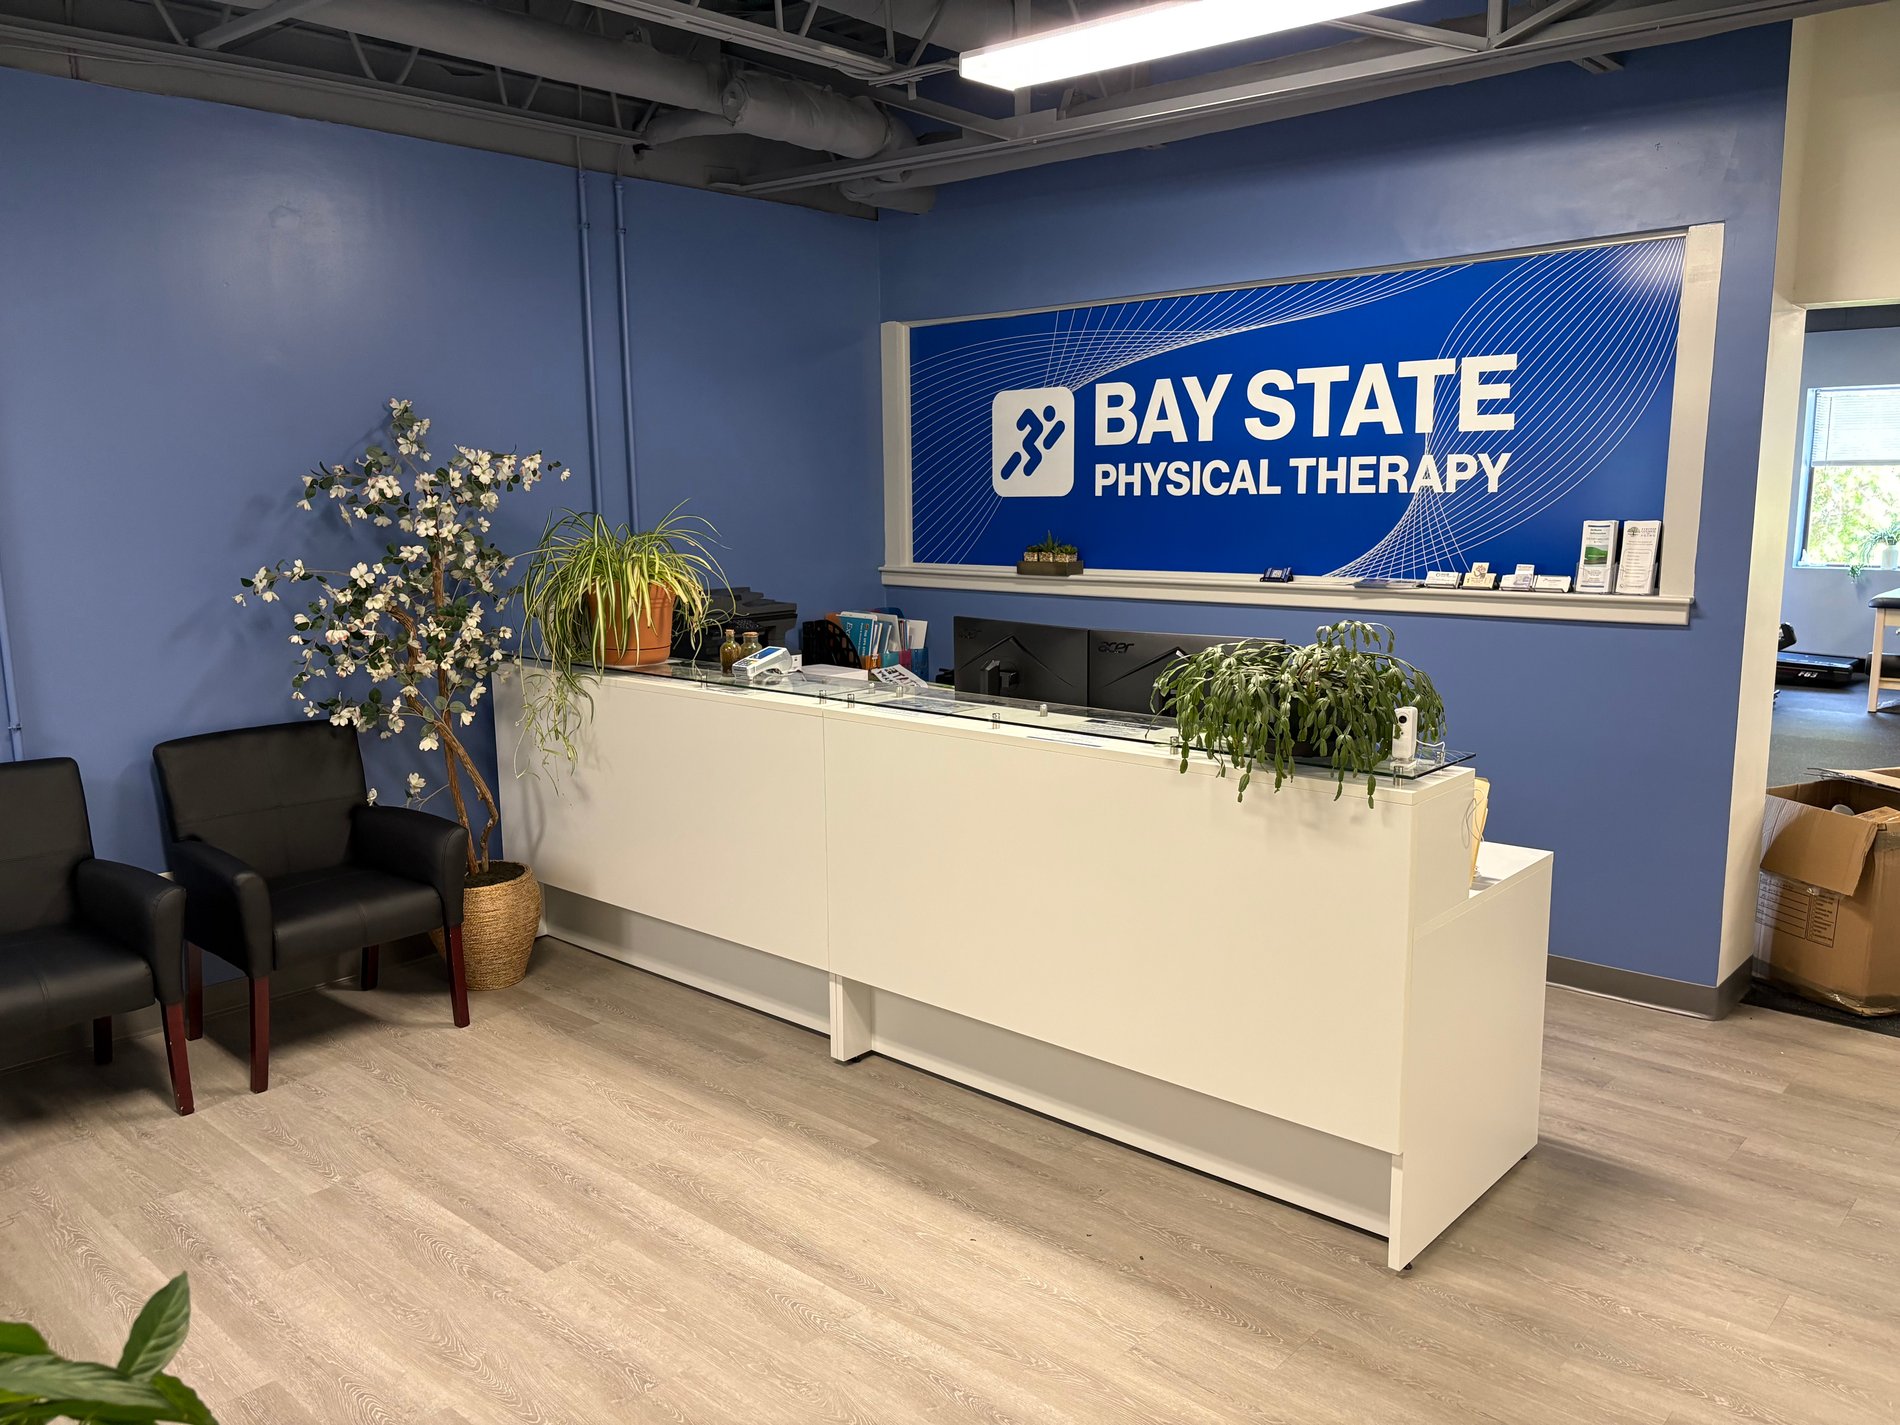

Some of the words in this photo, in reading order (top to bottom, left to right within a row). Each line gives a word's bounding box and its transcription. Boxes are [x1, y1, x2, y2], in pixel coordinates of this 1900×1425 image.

[1094, 373, 1232, 446] BAY
[1244, 353, 1518, 440] STATE
[1094, 458, 1281, 496] PHYSICAL
[1288, 452, 1512, 494] THERAPY
[1097, 641, 1135, 654] acer
[1797, 670, 1819, 678] F63
